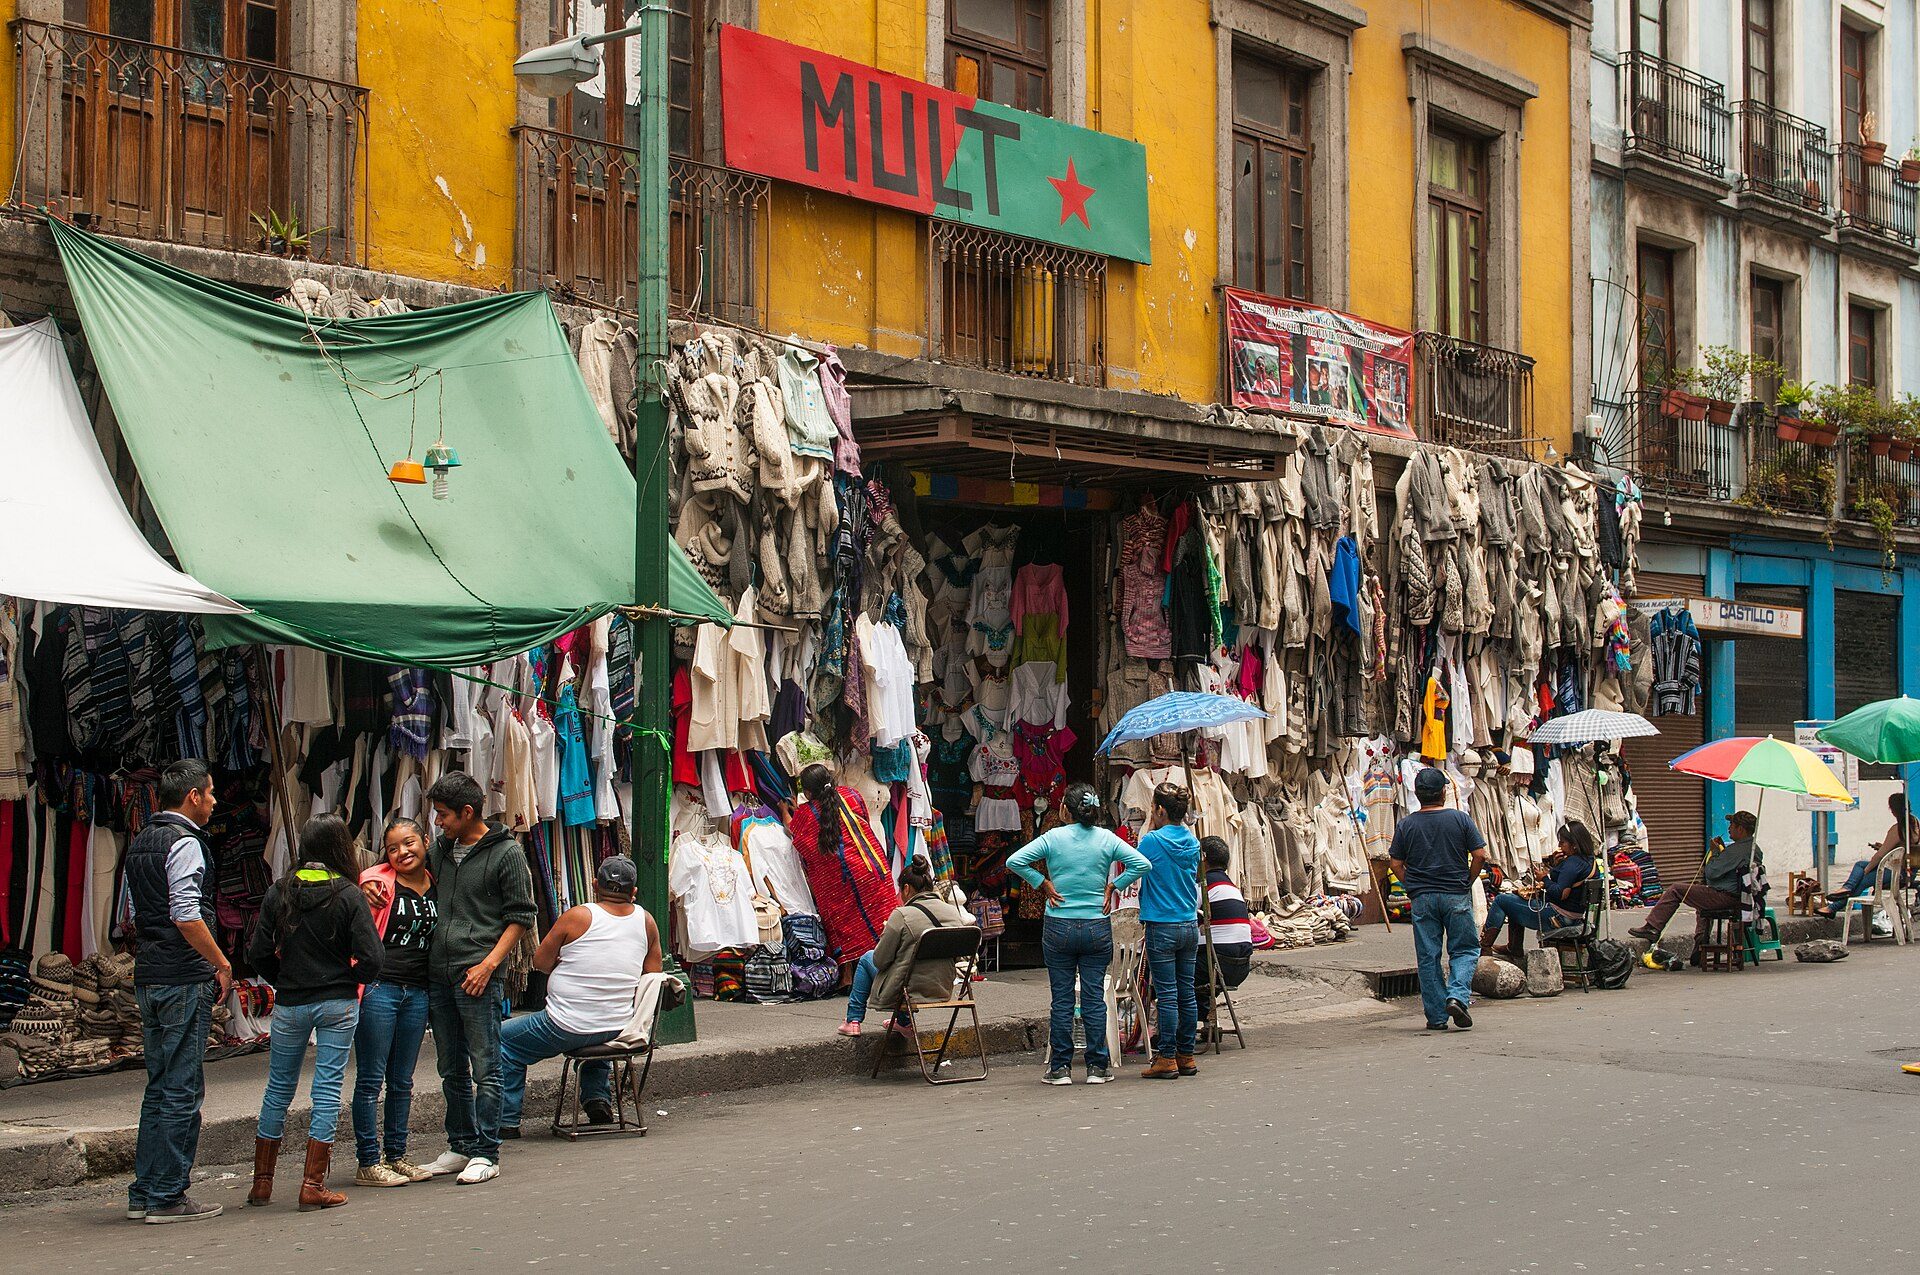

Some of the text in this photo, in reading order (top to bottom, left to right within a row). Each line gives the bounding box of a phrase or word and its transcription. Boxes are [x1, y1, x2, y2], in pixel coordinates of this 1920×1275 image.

[800, 61, 1020, 216] MULT
[1719, 602, 1774, 625] CASTILLO
[397, 897, 438, 917] AER
